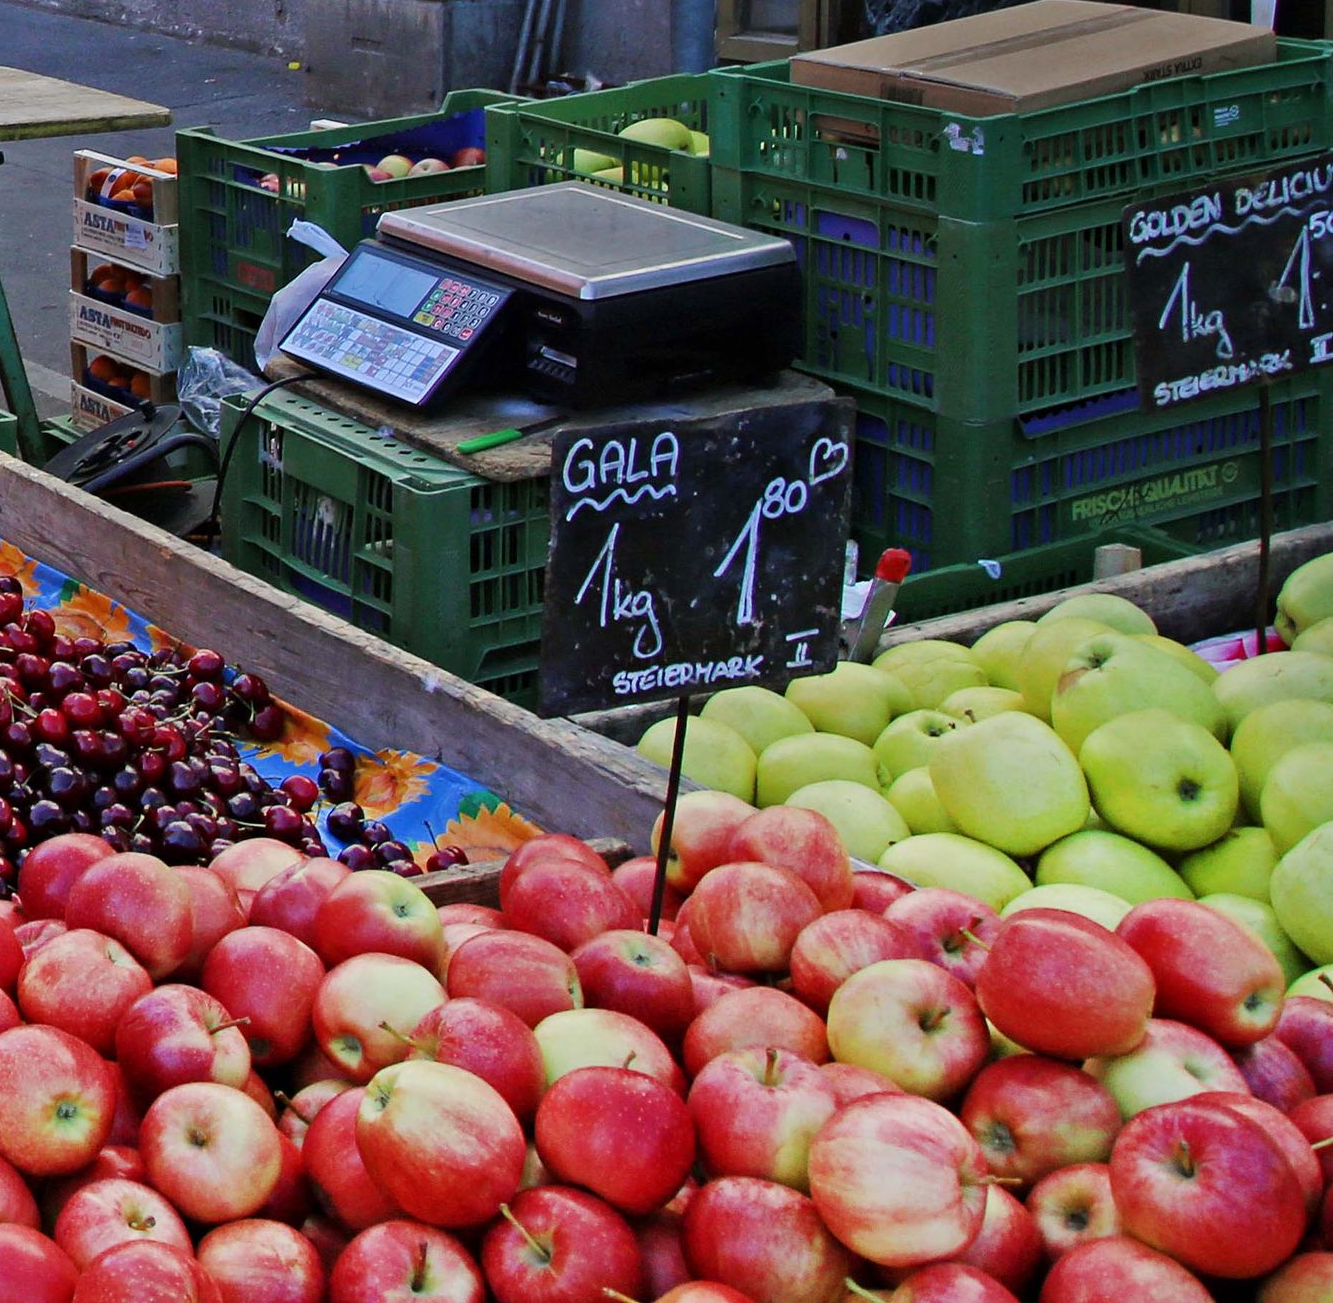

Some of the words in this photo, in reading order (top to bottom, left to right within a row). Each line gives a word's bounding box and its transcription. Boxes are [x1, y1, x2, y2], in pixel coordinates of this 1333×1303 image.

[1130, 192, 1222, 246] GOLDEN
[80, 304, 112, 330] ASTA
[563, 432, 679, 494] GALA
[613, 654, 765, 695] STEIERMARK
